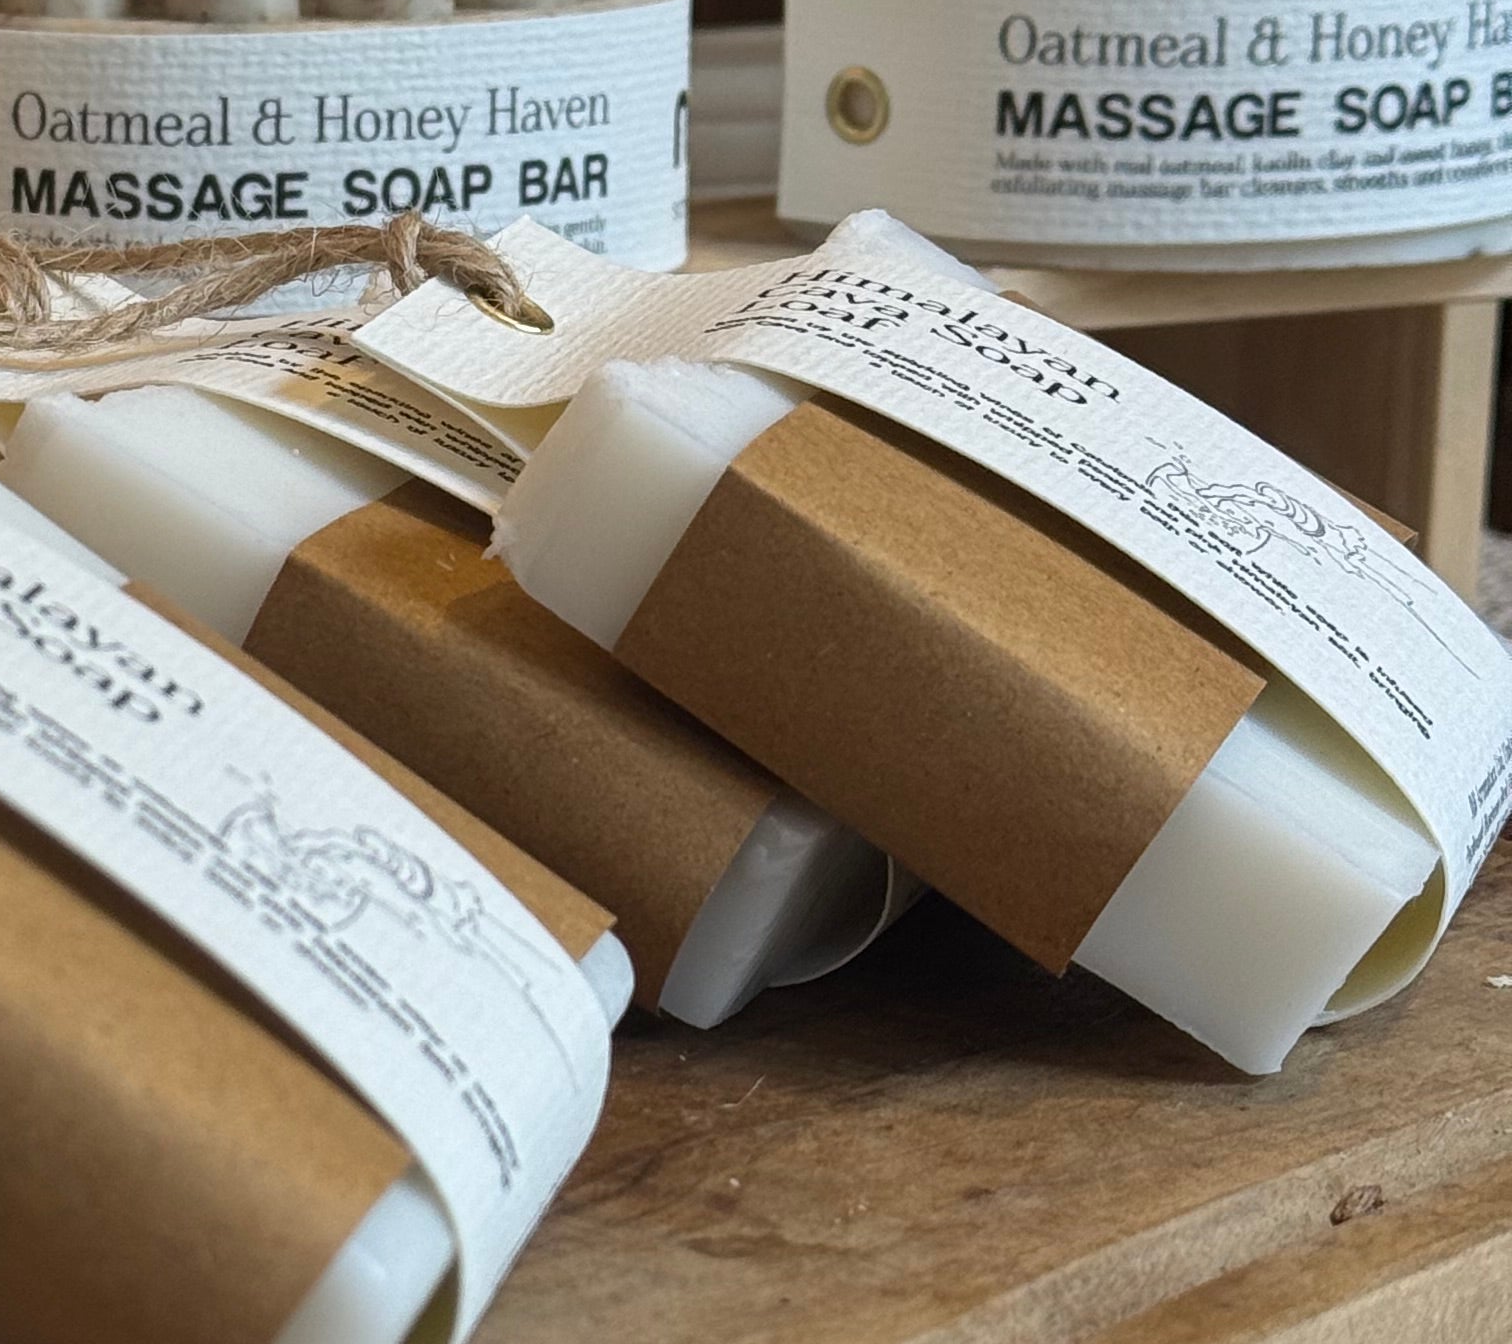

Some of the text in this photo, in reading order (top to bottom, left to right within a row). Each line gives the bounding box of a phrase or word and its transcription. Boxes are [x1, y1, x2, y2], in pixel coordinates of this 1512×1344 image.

[997, 14, 1228, 69] Oatmeal
[1245, 18, 1289, 67] &
[1309, 10, 1455, 69] Honey
[11, 90, 230, 146] Oatmeal
[251, 97, 295, 146] &
[314, 93, 473, 154] Honey
[488, 88, 610, 136] Haven
[996, 91, 1302, 140] MASSAGE
[1334, 79, 1471, 134] SOAP
[11, 153, 609, 221] MASSAGE SOAP BAR
[735, 301, 901, 330] Loaf
[757, 282, 1088, 405] Cava Soap
[780, 269, 1120, 404] Himalayan
